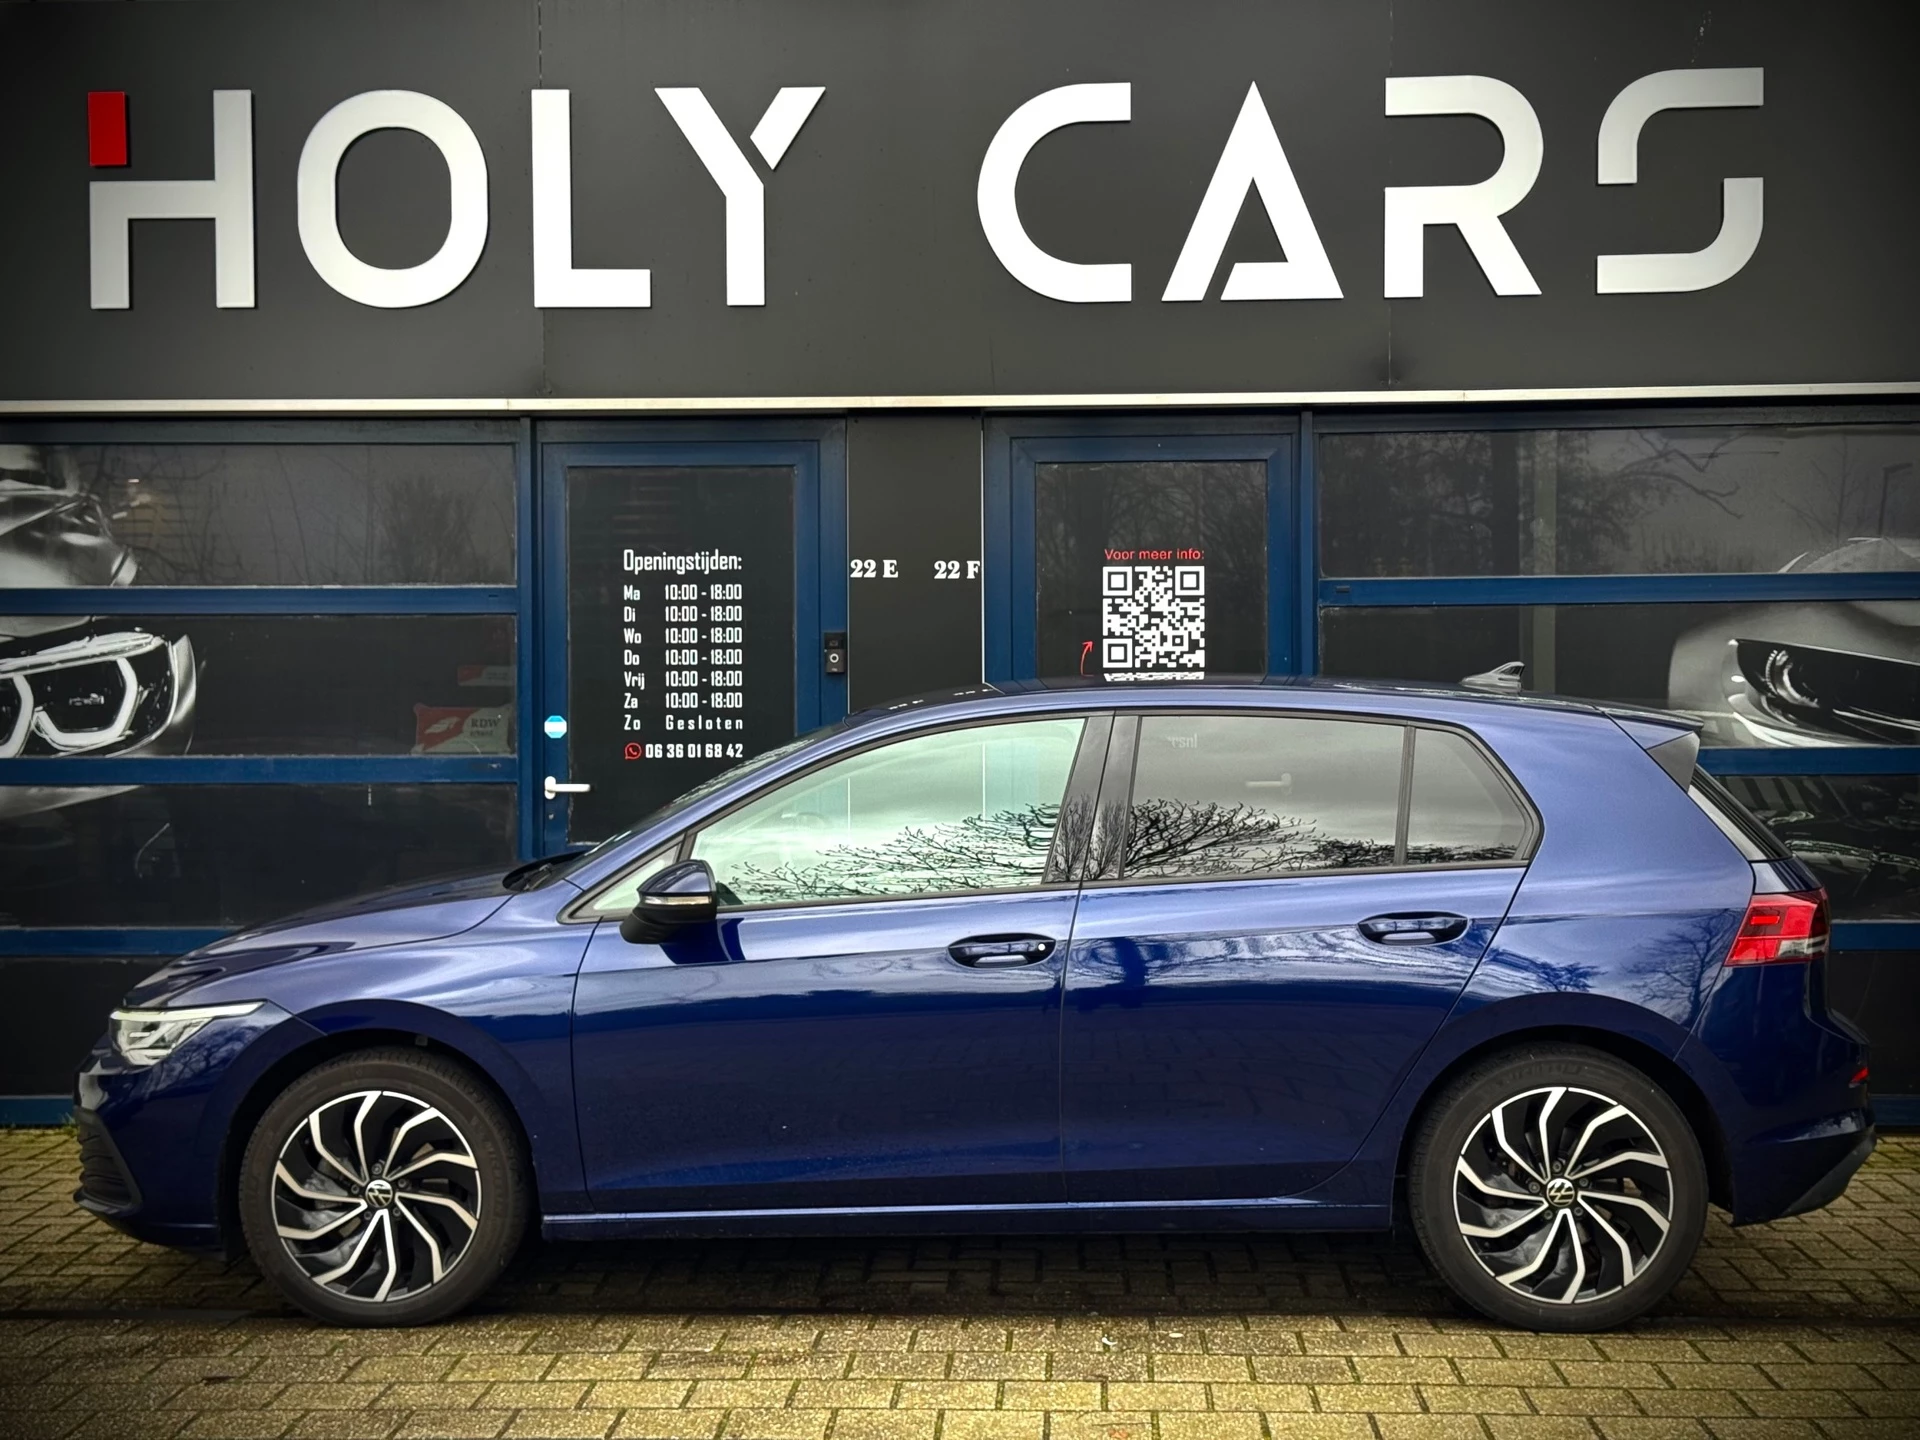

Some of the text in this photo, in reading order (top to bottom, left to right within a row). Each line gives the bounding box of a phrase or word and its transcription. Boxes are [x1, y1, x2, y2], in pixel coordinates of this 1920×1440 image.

[88, 68, 1763, 310] HOLY CARS
[624, 549, 742, 575] Openingstijden:
[1104, 548, 1205, 560] Voor meer info:
[850, 559, 898, 578] 22 E
[934, 561, 980, 579] 22 F
[624, 585, 640, 600] Ma
[665, 584, 697, 600] 10:00
[711, 584, 742, 600] 18:00
[624, 606, 635, 622] Di
[665, 606, 697, 622] 10:00
[711, 606, 742, 621] 18:00
[624, 628, 641, 643] Wo
[666, 628, 697, 643] 10:00
[711, 627, 742, 643] 18:00
[624, 650, 639, 665] Do
[666, 649, 698, 665] 10:00
[711, 649, 742, 664] 18:00
[624, 671, 644, 690] Vrij
[666, 671, 698, 686] 10:00
[711, 671, 742, 686] 18:00
[624, 693, 638, 708] Za
[666, 693, 698, 708] 10:00
[711, 692, 742, 708] 18:00
[471, 718, 500, 728] RDW
[624, 715, 742, 730] Zo Gesloten
[646, 744, 743, 758] 06 36 01 68 42
